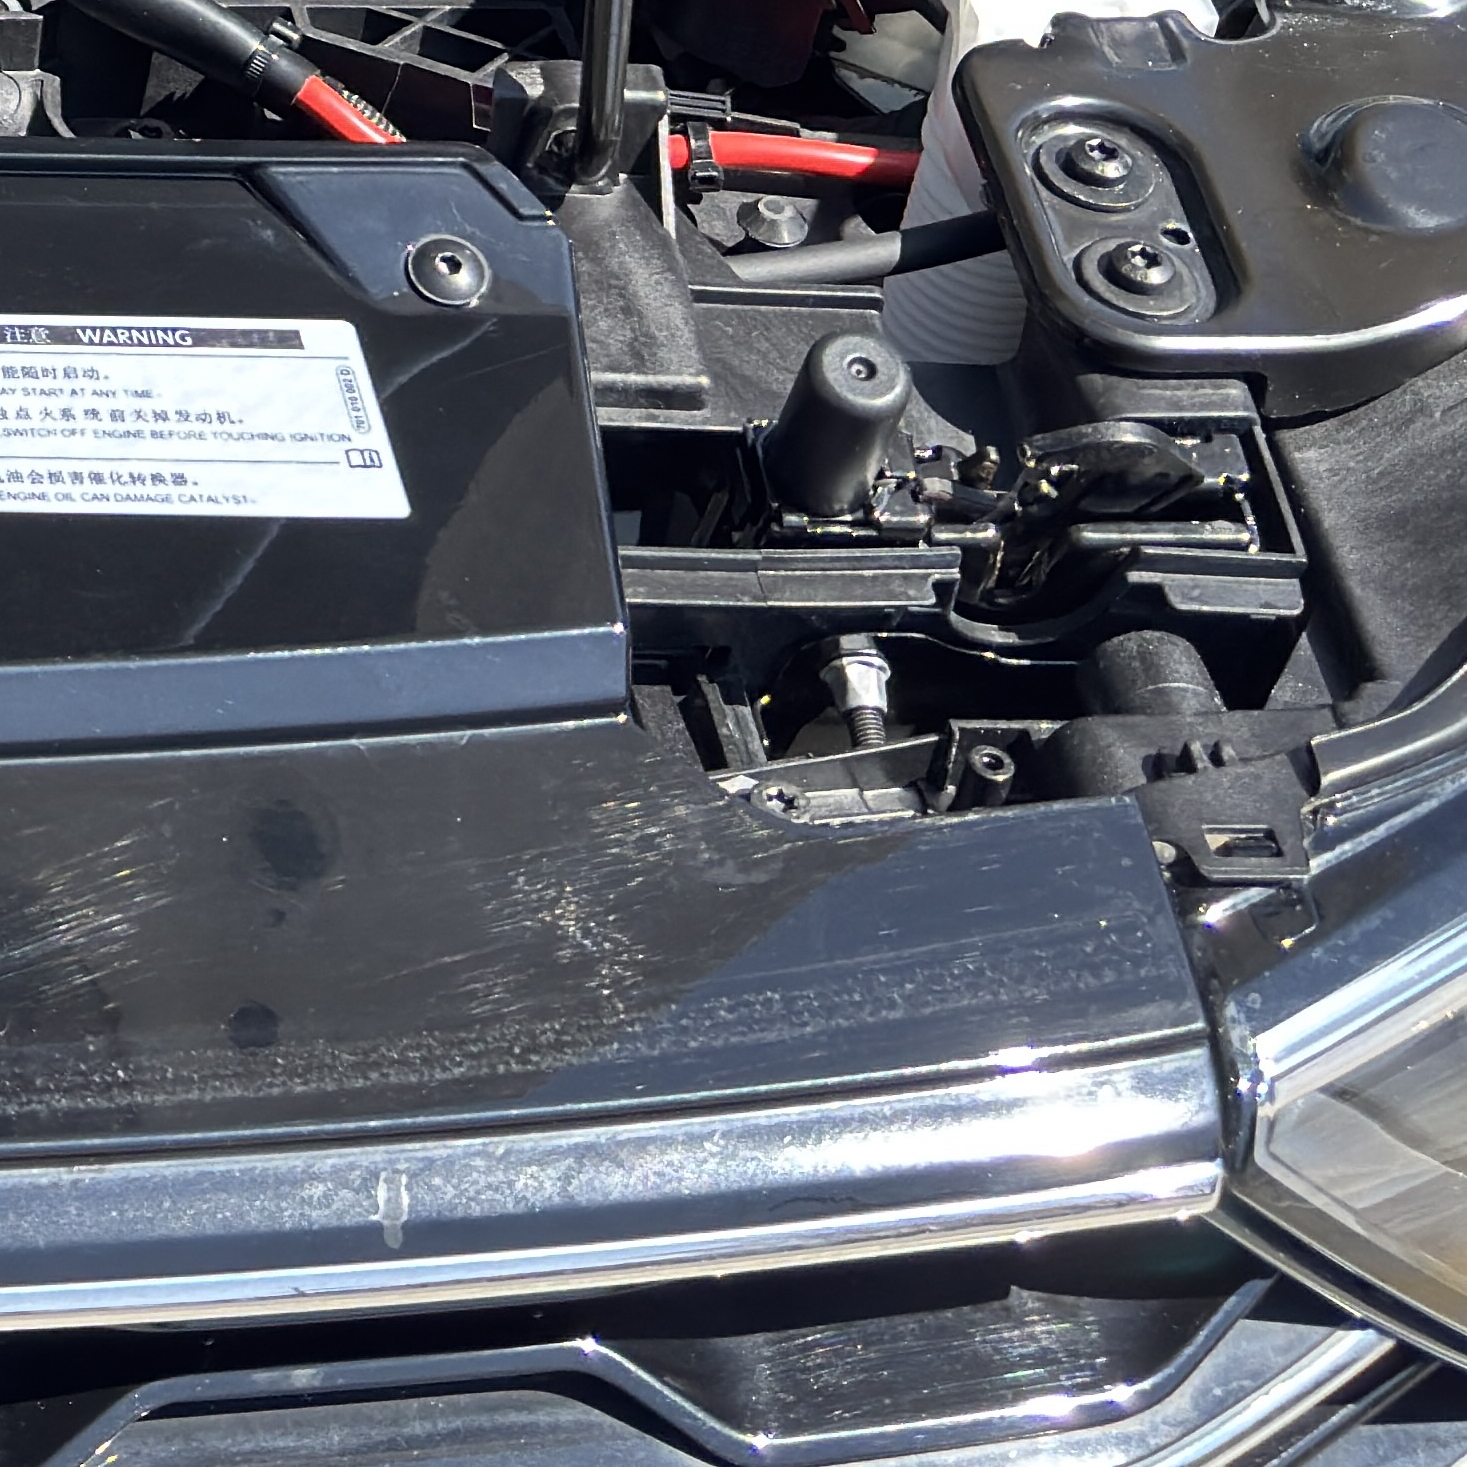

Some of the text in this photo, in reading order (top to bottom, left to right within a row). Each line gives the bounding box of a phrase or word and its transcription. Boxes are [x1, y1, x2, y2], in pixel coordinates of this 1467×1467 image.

[3, 326, 193, 348] 注意 WARNING
[22, 386, 65, 397] START
[70, 387, 86, 397] AT
[91, 387, 117, 398] ANY
[61, 428, 87, 438] OFF
[93, 429, 146, 440] ENGINE
[150, 430, 207, 441] BEFORE
[212, 431, 286, 442] TOUCHING
[290, 432, 352, 443] IGNITION
[54, 490, 76, 502] OIL
[81, 492, 110, 503] CAN
[114, 493, 174, 504] DAMAGE
